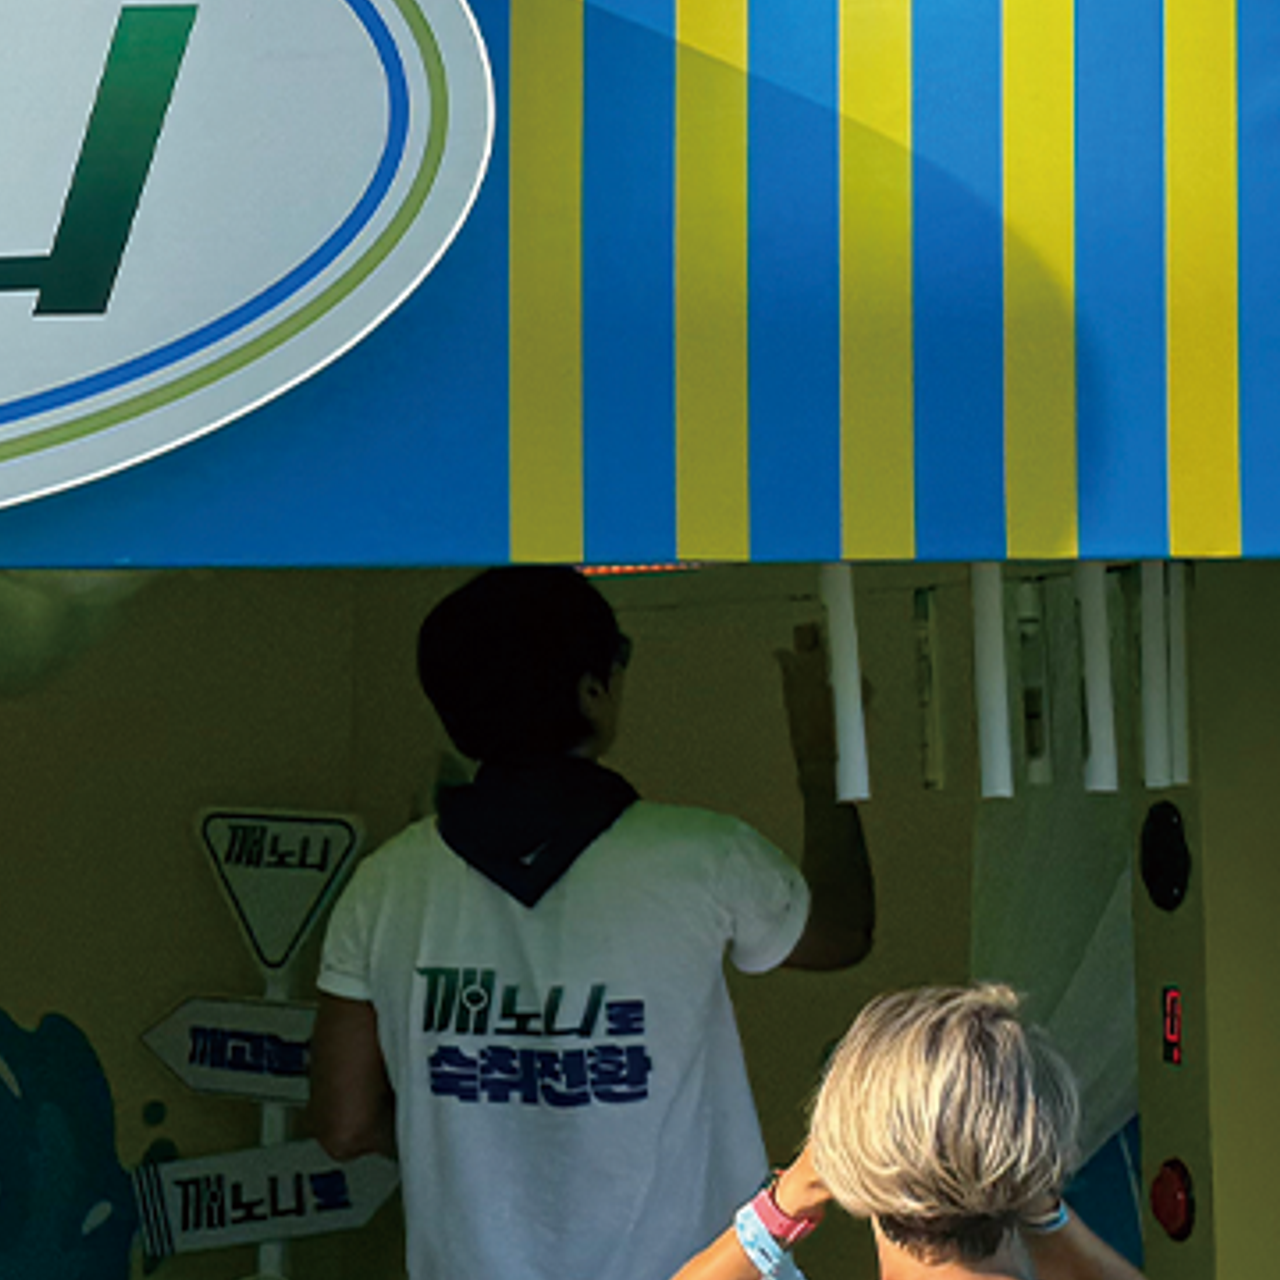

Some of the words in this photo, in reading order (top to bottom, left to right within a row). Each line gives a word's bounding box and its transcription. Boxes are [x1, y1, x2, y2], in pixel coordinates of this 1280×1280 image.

[225, 824, 331, 872] 깨노니
[416, 966, 646, 1038] 깨노니로
[428, 1045, 653, 1108] 숙취전환
